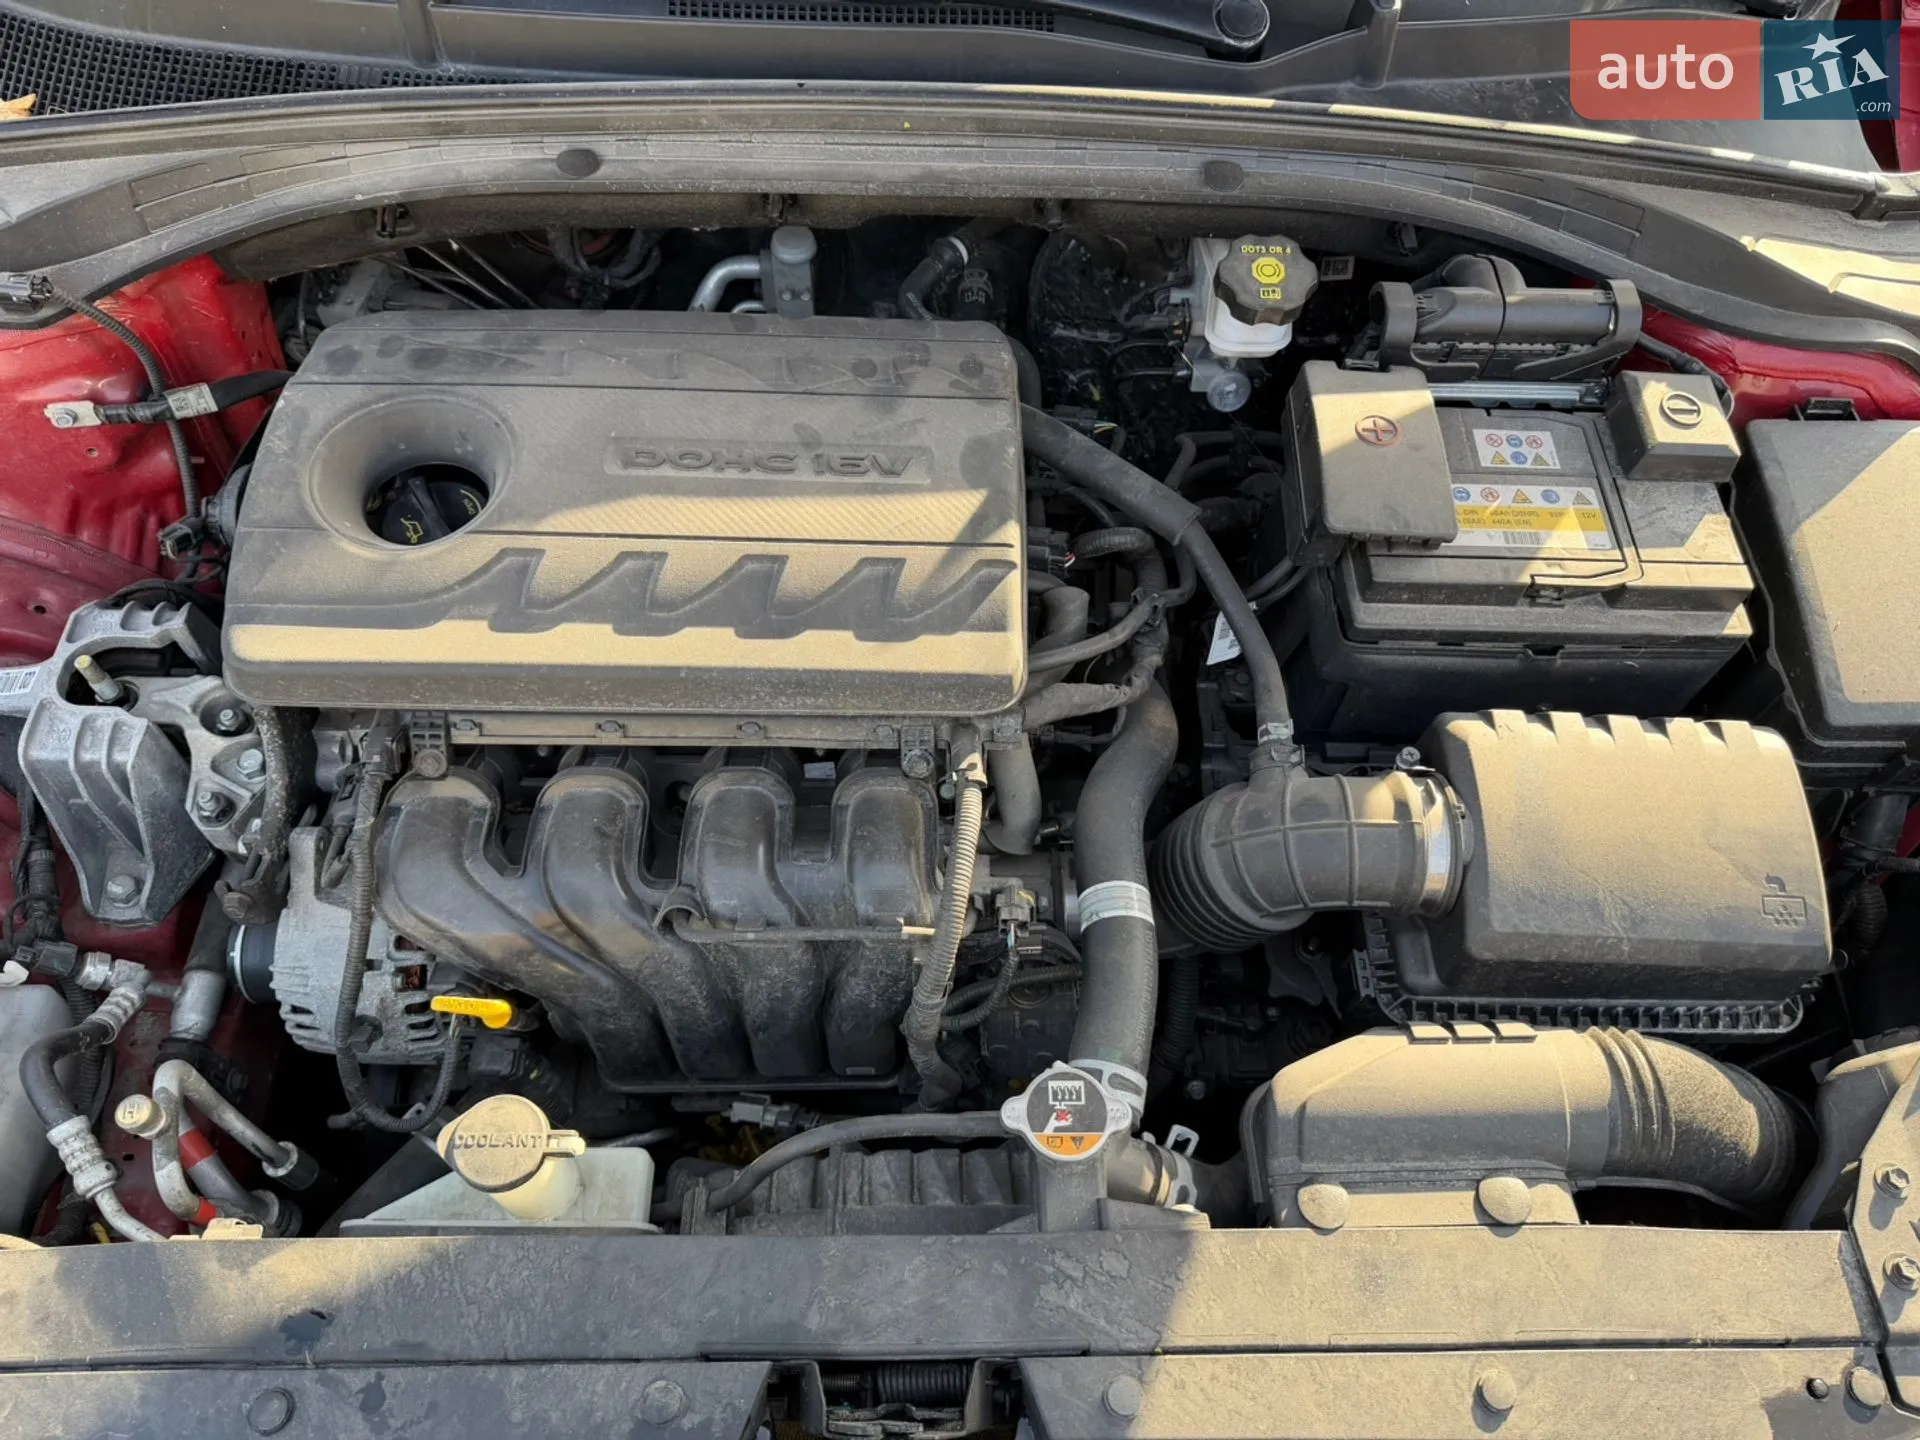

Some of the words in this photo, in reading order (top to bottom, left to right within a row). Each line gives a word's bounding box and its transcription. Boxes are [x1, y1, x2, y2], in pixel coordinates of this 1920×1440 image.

[1241, 245, 1266, 254] DOT3
[1269, 246, 1283, 254] OR
[1286, 246, 1292, 254] 4
[621, 447, 798, 475] DOHC
[812, 452, 913, 478] 16V
[452, 1131, 542, 1150] COOLANT
